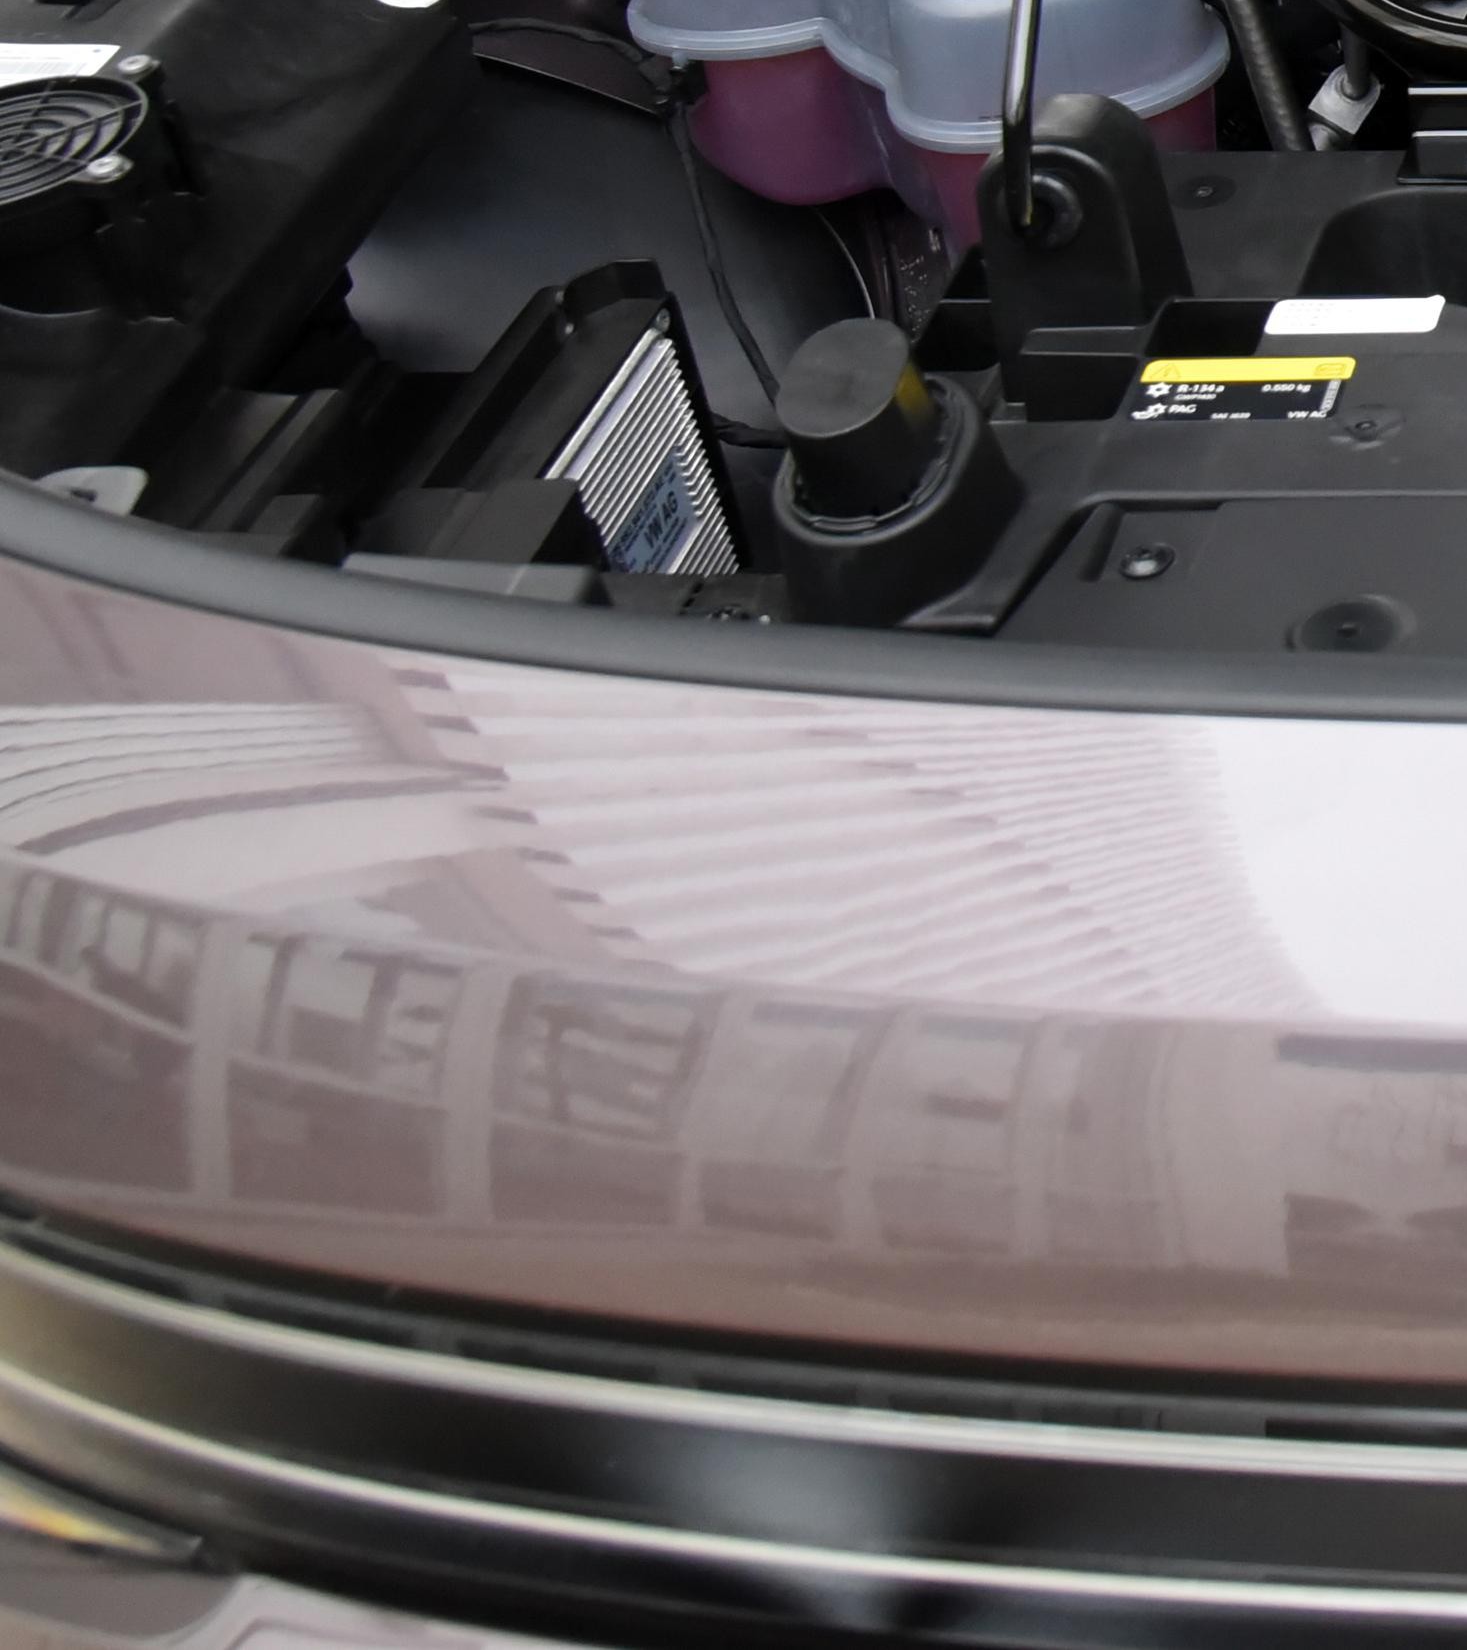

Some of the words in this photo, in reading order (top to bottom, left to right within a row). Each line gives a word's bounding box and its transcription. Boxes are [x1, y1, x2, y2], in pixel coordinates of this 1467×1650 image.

[1168, 404, 1197, 414] PAG
[1287, 410, 1308, 419] VW
[1309, 410, 1327, 419] AG
